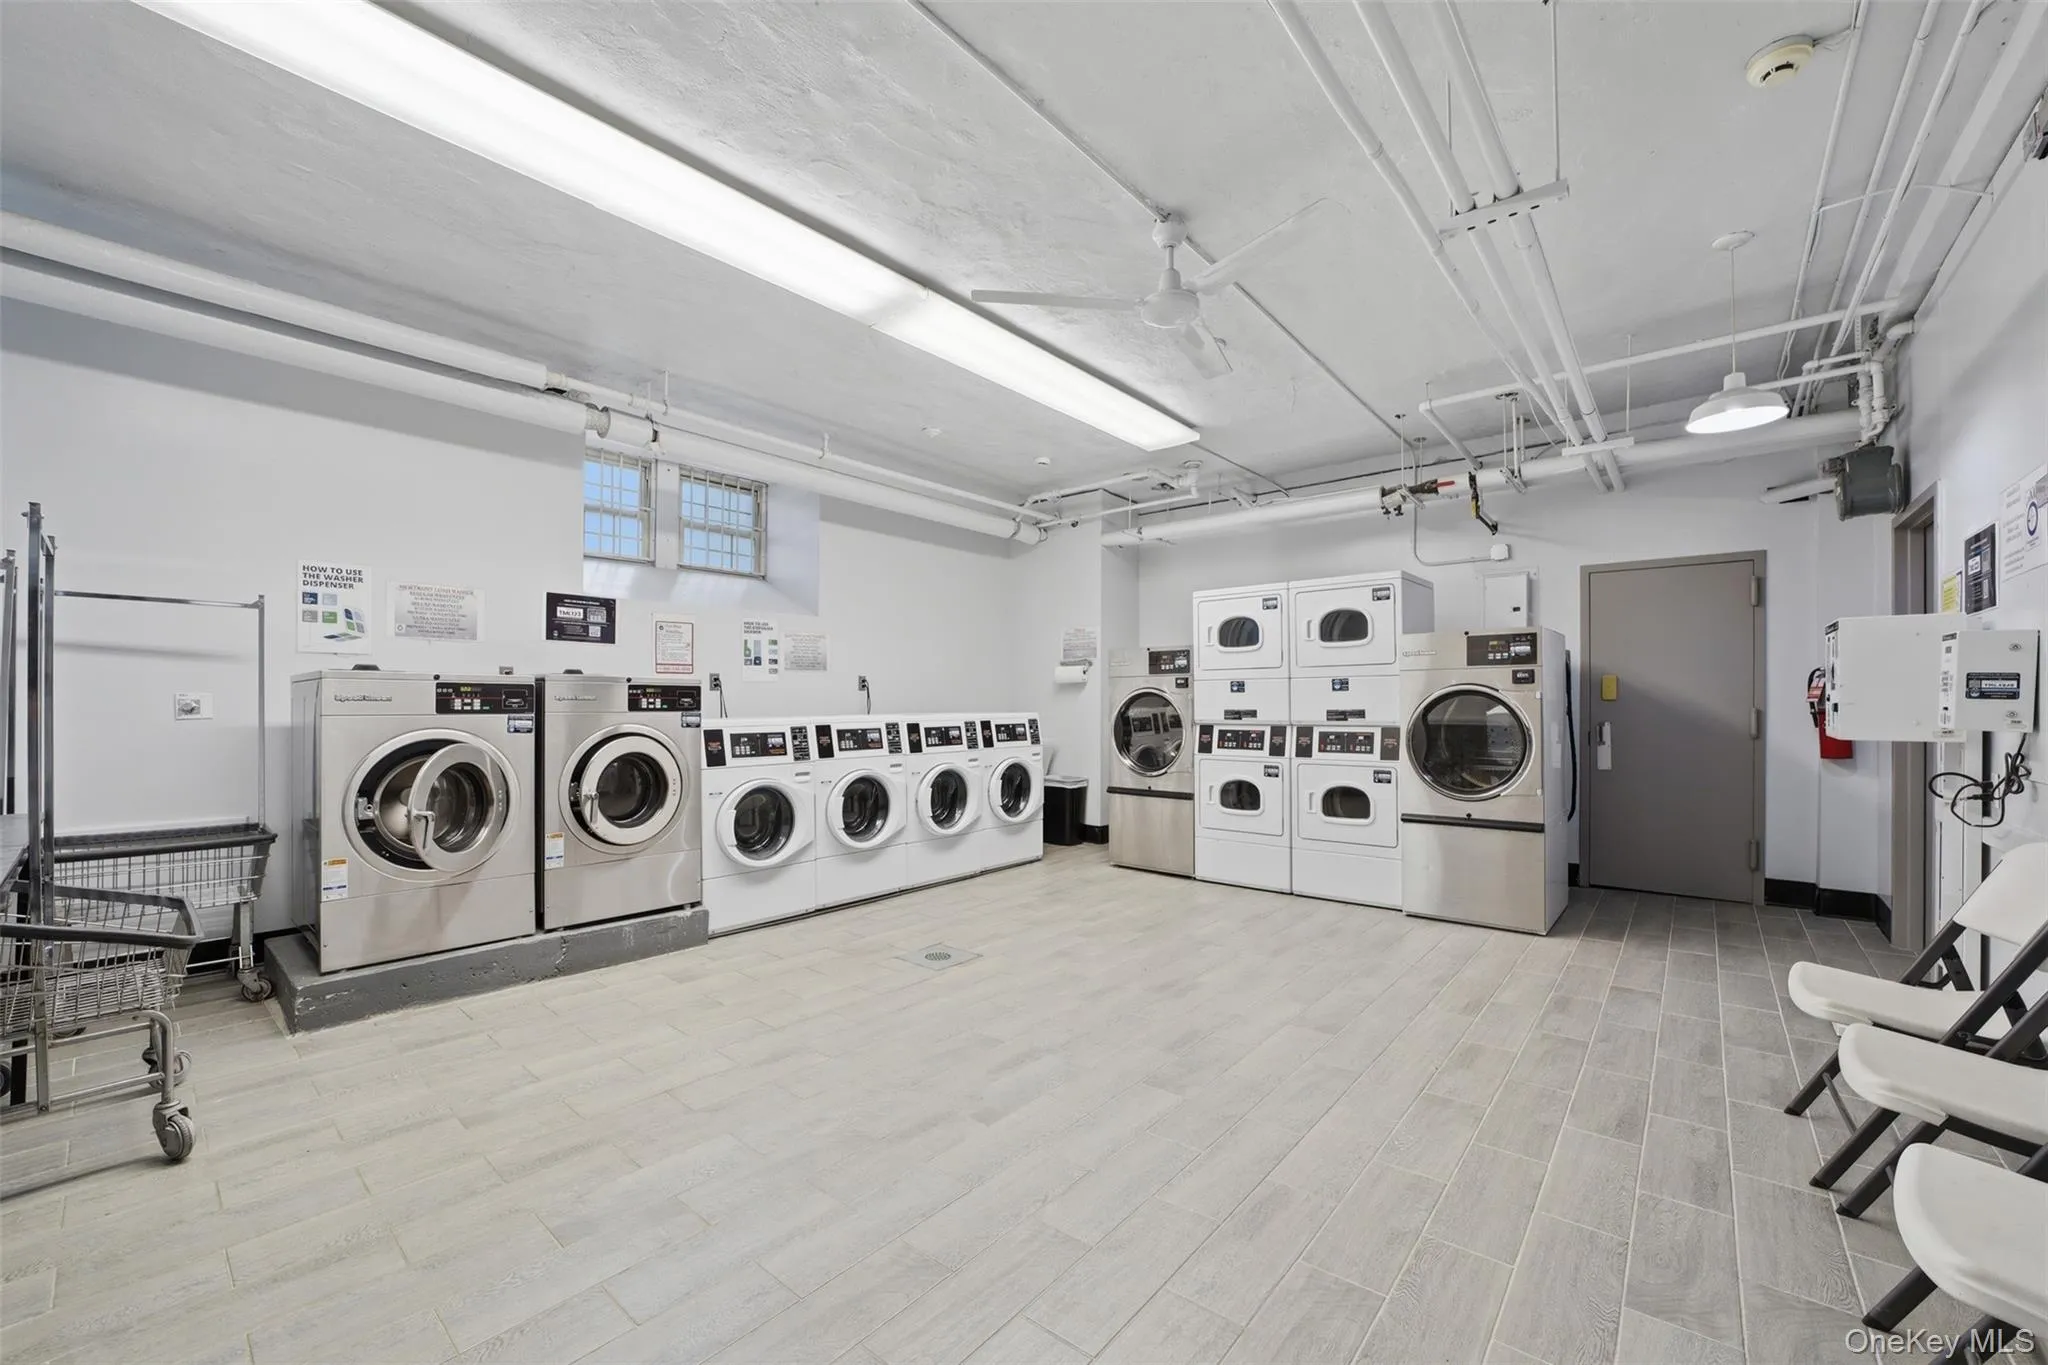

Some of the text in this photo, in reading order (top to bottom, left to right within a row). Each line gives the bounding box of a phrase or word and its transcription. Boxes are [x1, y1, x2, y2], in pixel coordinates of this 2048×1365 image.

[302, 565, 327, 573] HOW
[331, 567, 343, 575] TO
[324, 574, 364, 583] WASHER
[302, 580, 355, 589] DISPENSER
